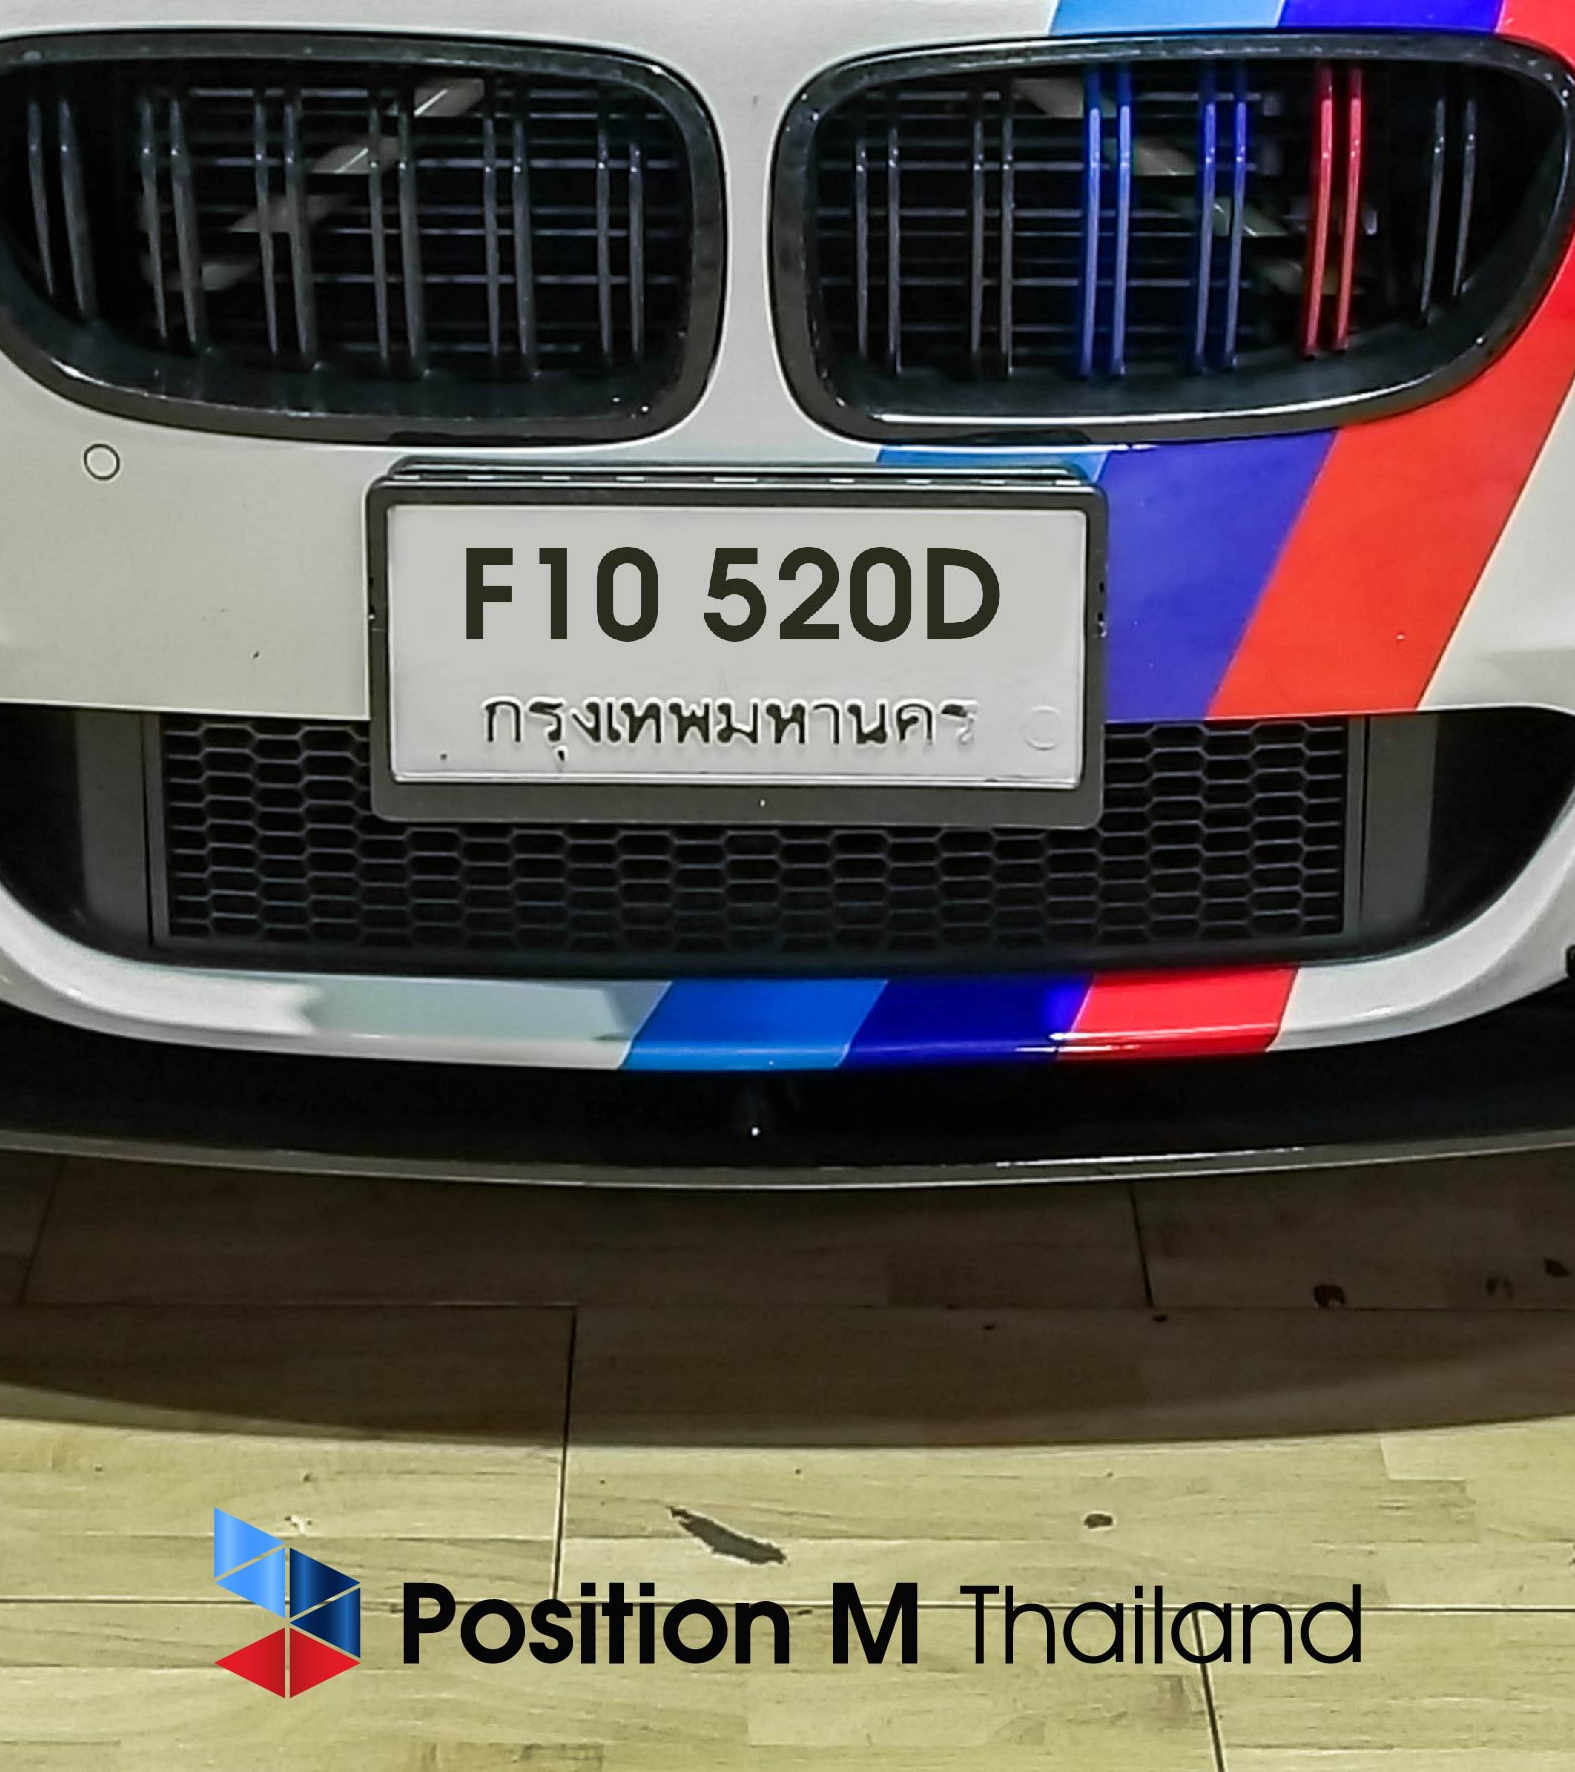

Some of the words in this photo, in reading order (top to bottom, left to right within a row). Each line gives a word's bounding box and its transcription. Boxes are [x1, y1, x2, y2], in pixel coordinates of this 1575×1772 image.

[465, 546, 660, 643] F10
[703, 546, 1001, 643] 520D
[483, 697, 978, 762] กรุงเทพมหานคร
